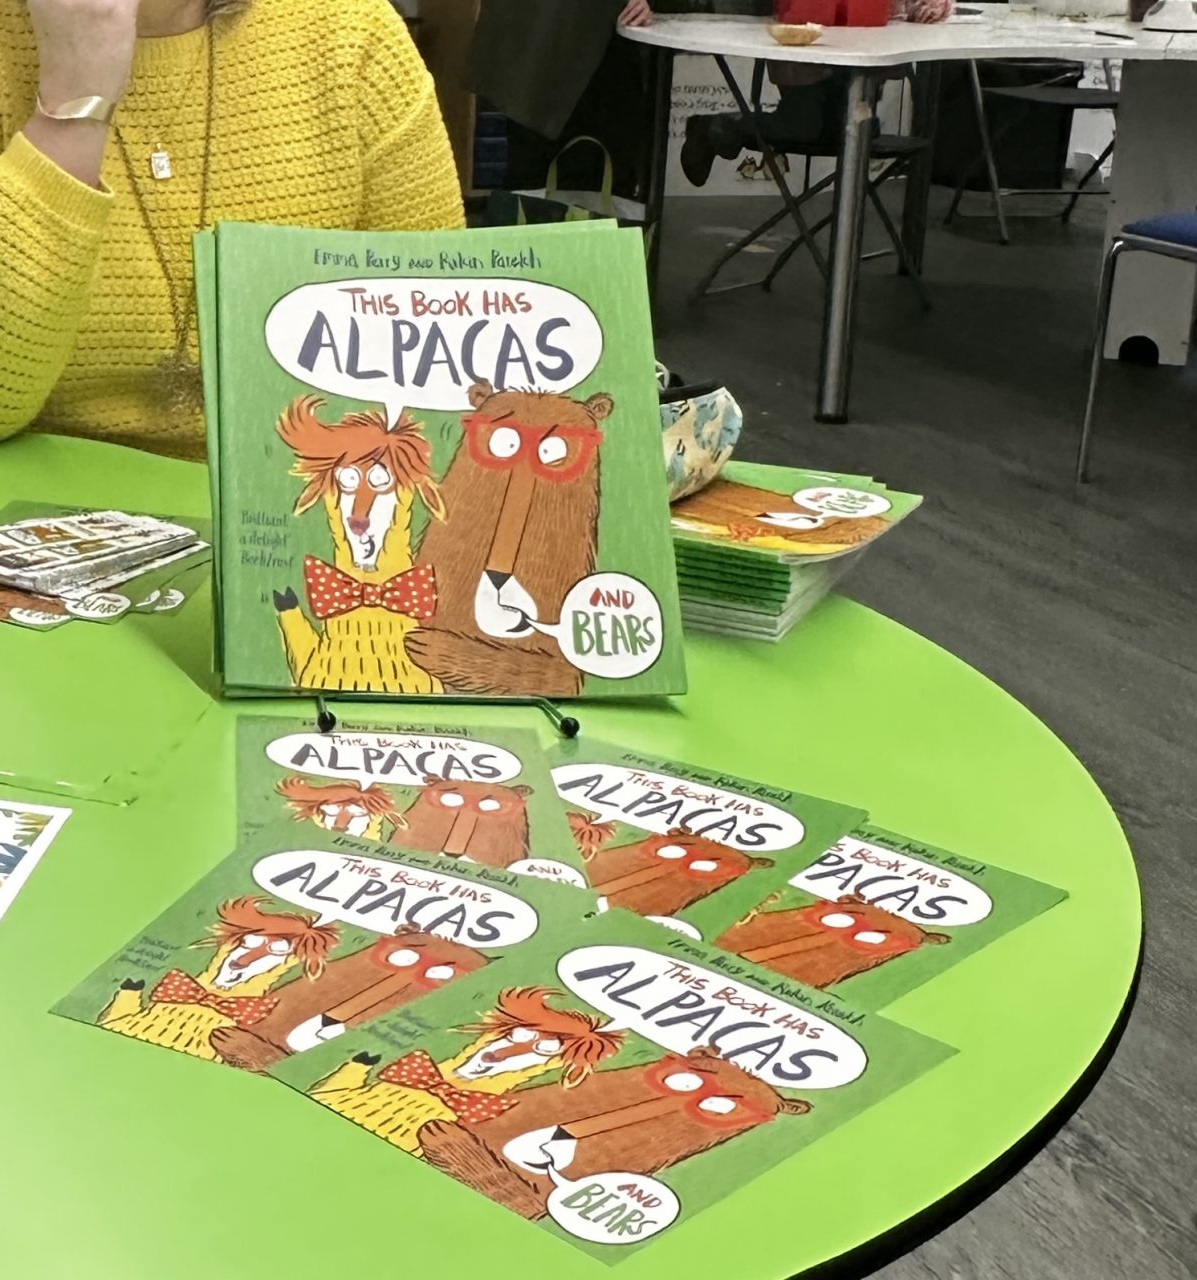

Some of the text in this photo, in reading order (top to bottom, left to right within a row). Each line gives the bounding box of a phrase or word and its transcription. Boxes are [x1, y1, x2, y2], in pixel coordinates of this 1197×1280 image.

[313, 247, 359, 269] Emma
[365, 248, 401, 271] Perry
[439, 251, 484, 270] Rikin
[490, 246, 542, 269] Parekh
[337, 287, 400, 317] THIS
[482, 289, 534, 316] HAS
[296, 310, 575, 390] ALPACAS
[589, 587, 635, 609] AND
[571, 609, 656, 656] BEARS
[290, 743, 503, 779] ALPACAS
[557, 773, 783, 846] ALPACAS
[625, 770, 664, 791] THIS
[725, 798, 764, 818] HAS
[269, 861, 516, 943] ALPACAS
[340, 856, 382, 879] THIS
[448, 883, 493, 905] HAS
[907, 867, 952, 889] HAS
[573, 960, 839, 1082] ALPACAS
[662, 960, 710, 992] THIS
[773, 1012, 825, 1041] HAS
[559, 1182, 659, 1237] BEARS
[617, 1182, 664, 1209] AND
